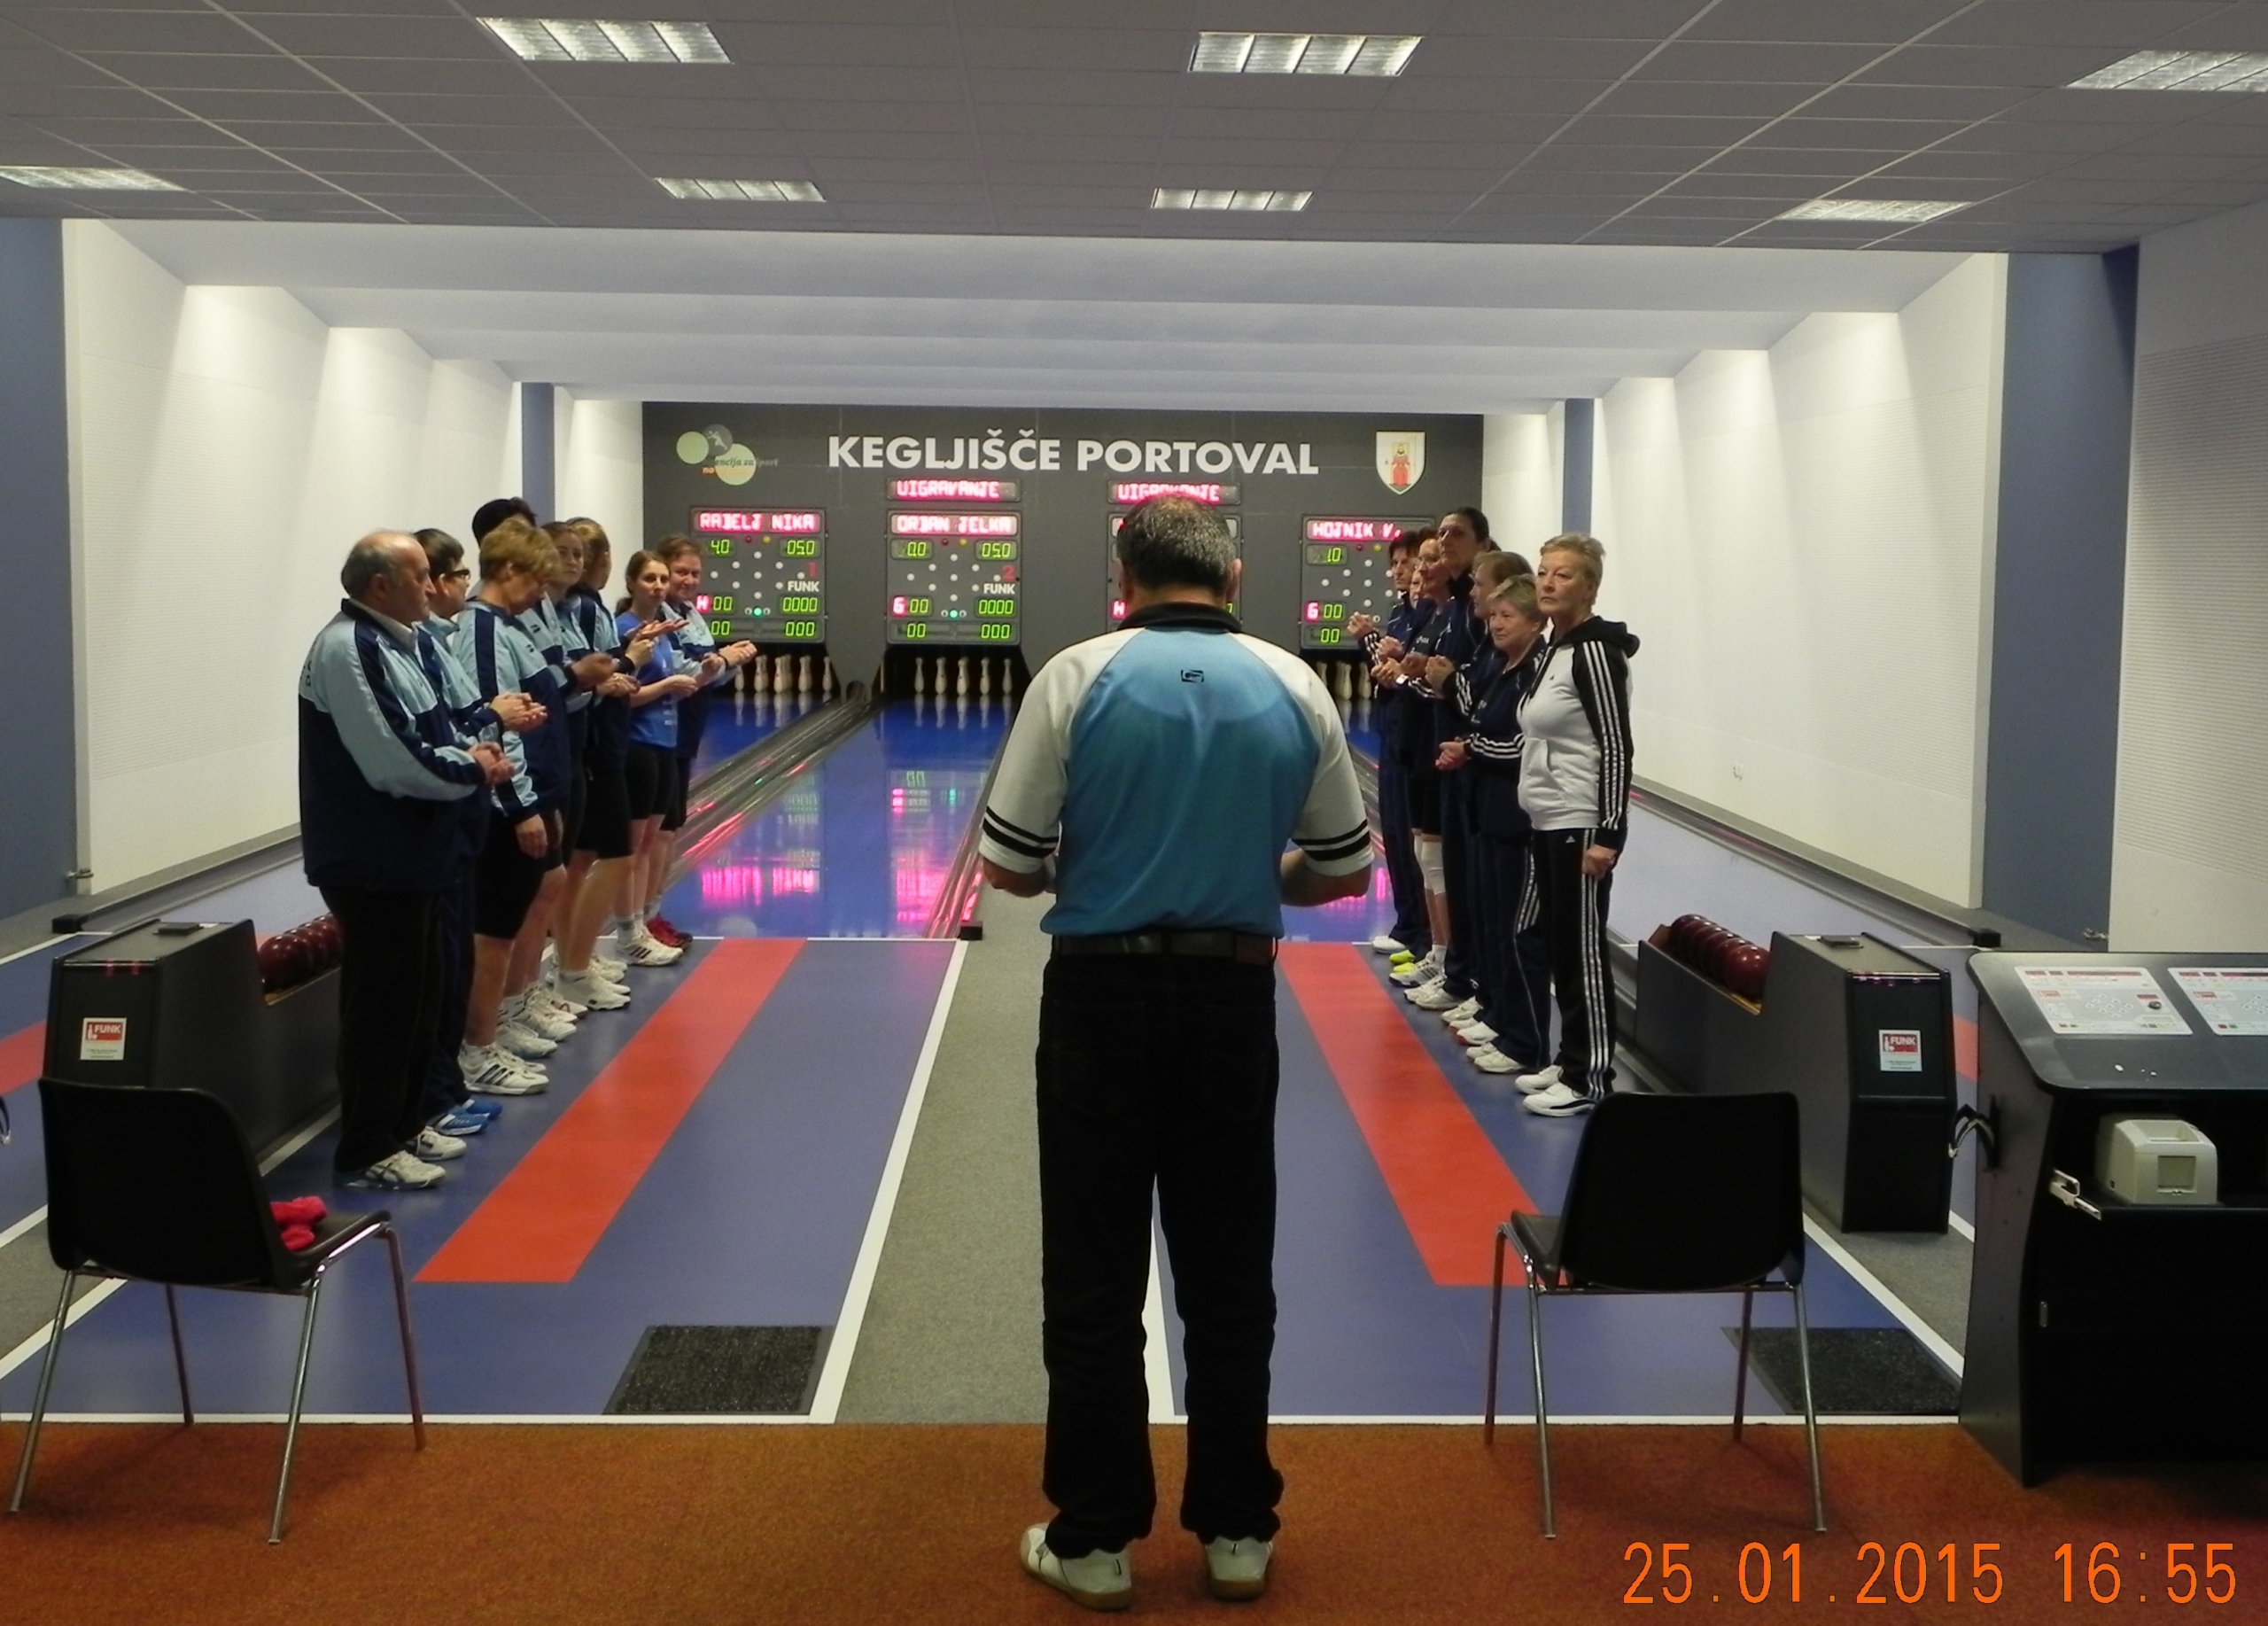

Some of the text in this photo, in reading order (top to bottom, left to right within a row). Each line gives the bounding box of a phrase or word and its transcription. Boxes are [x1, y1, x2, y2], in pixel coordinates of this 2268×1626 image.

[828, 429, 1319, 475] KEGLJIŠČE PORTOVAL
[772, 514, 815, 531] NIKA
[958, 516, 1012, 534] JELKA
[808, 563, 817, 578] 1
[1001, 564, 1015, 581] 2
[788, 580, 819, 593] FUNK
[983, 583, 1016, 595] FUNK
[713, 596, 733, 611] 00
[783, 597, 818, 612] 0000
[910, 598, 929, 613] 00
[979, 599, 1014, 615] 0000
[1324, 603, 1342, 619] 00
[711, 620, 730, 635] 00
[786, 621, 815, 636] 000
[907, 623, 926, 638] 00
[981, 624, 1011, 639] 000
[1321, 628, 1340, 643] 00
[94, 1024, 121, 1033] FUNK
